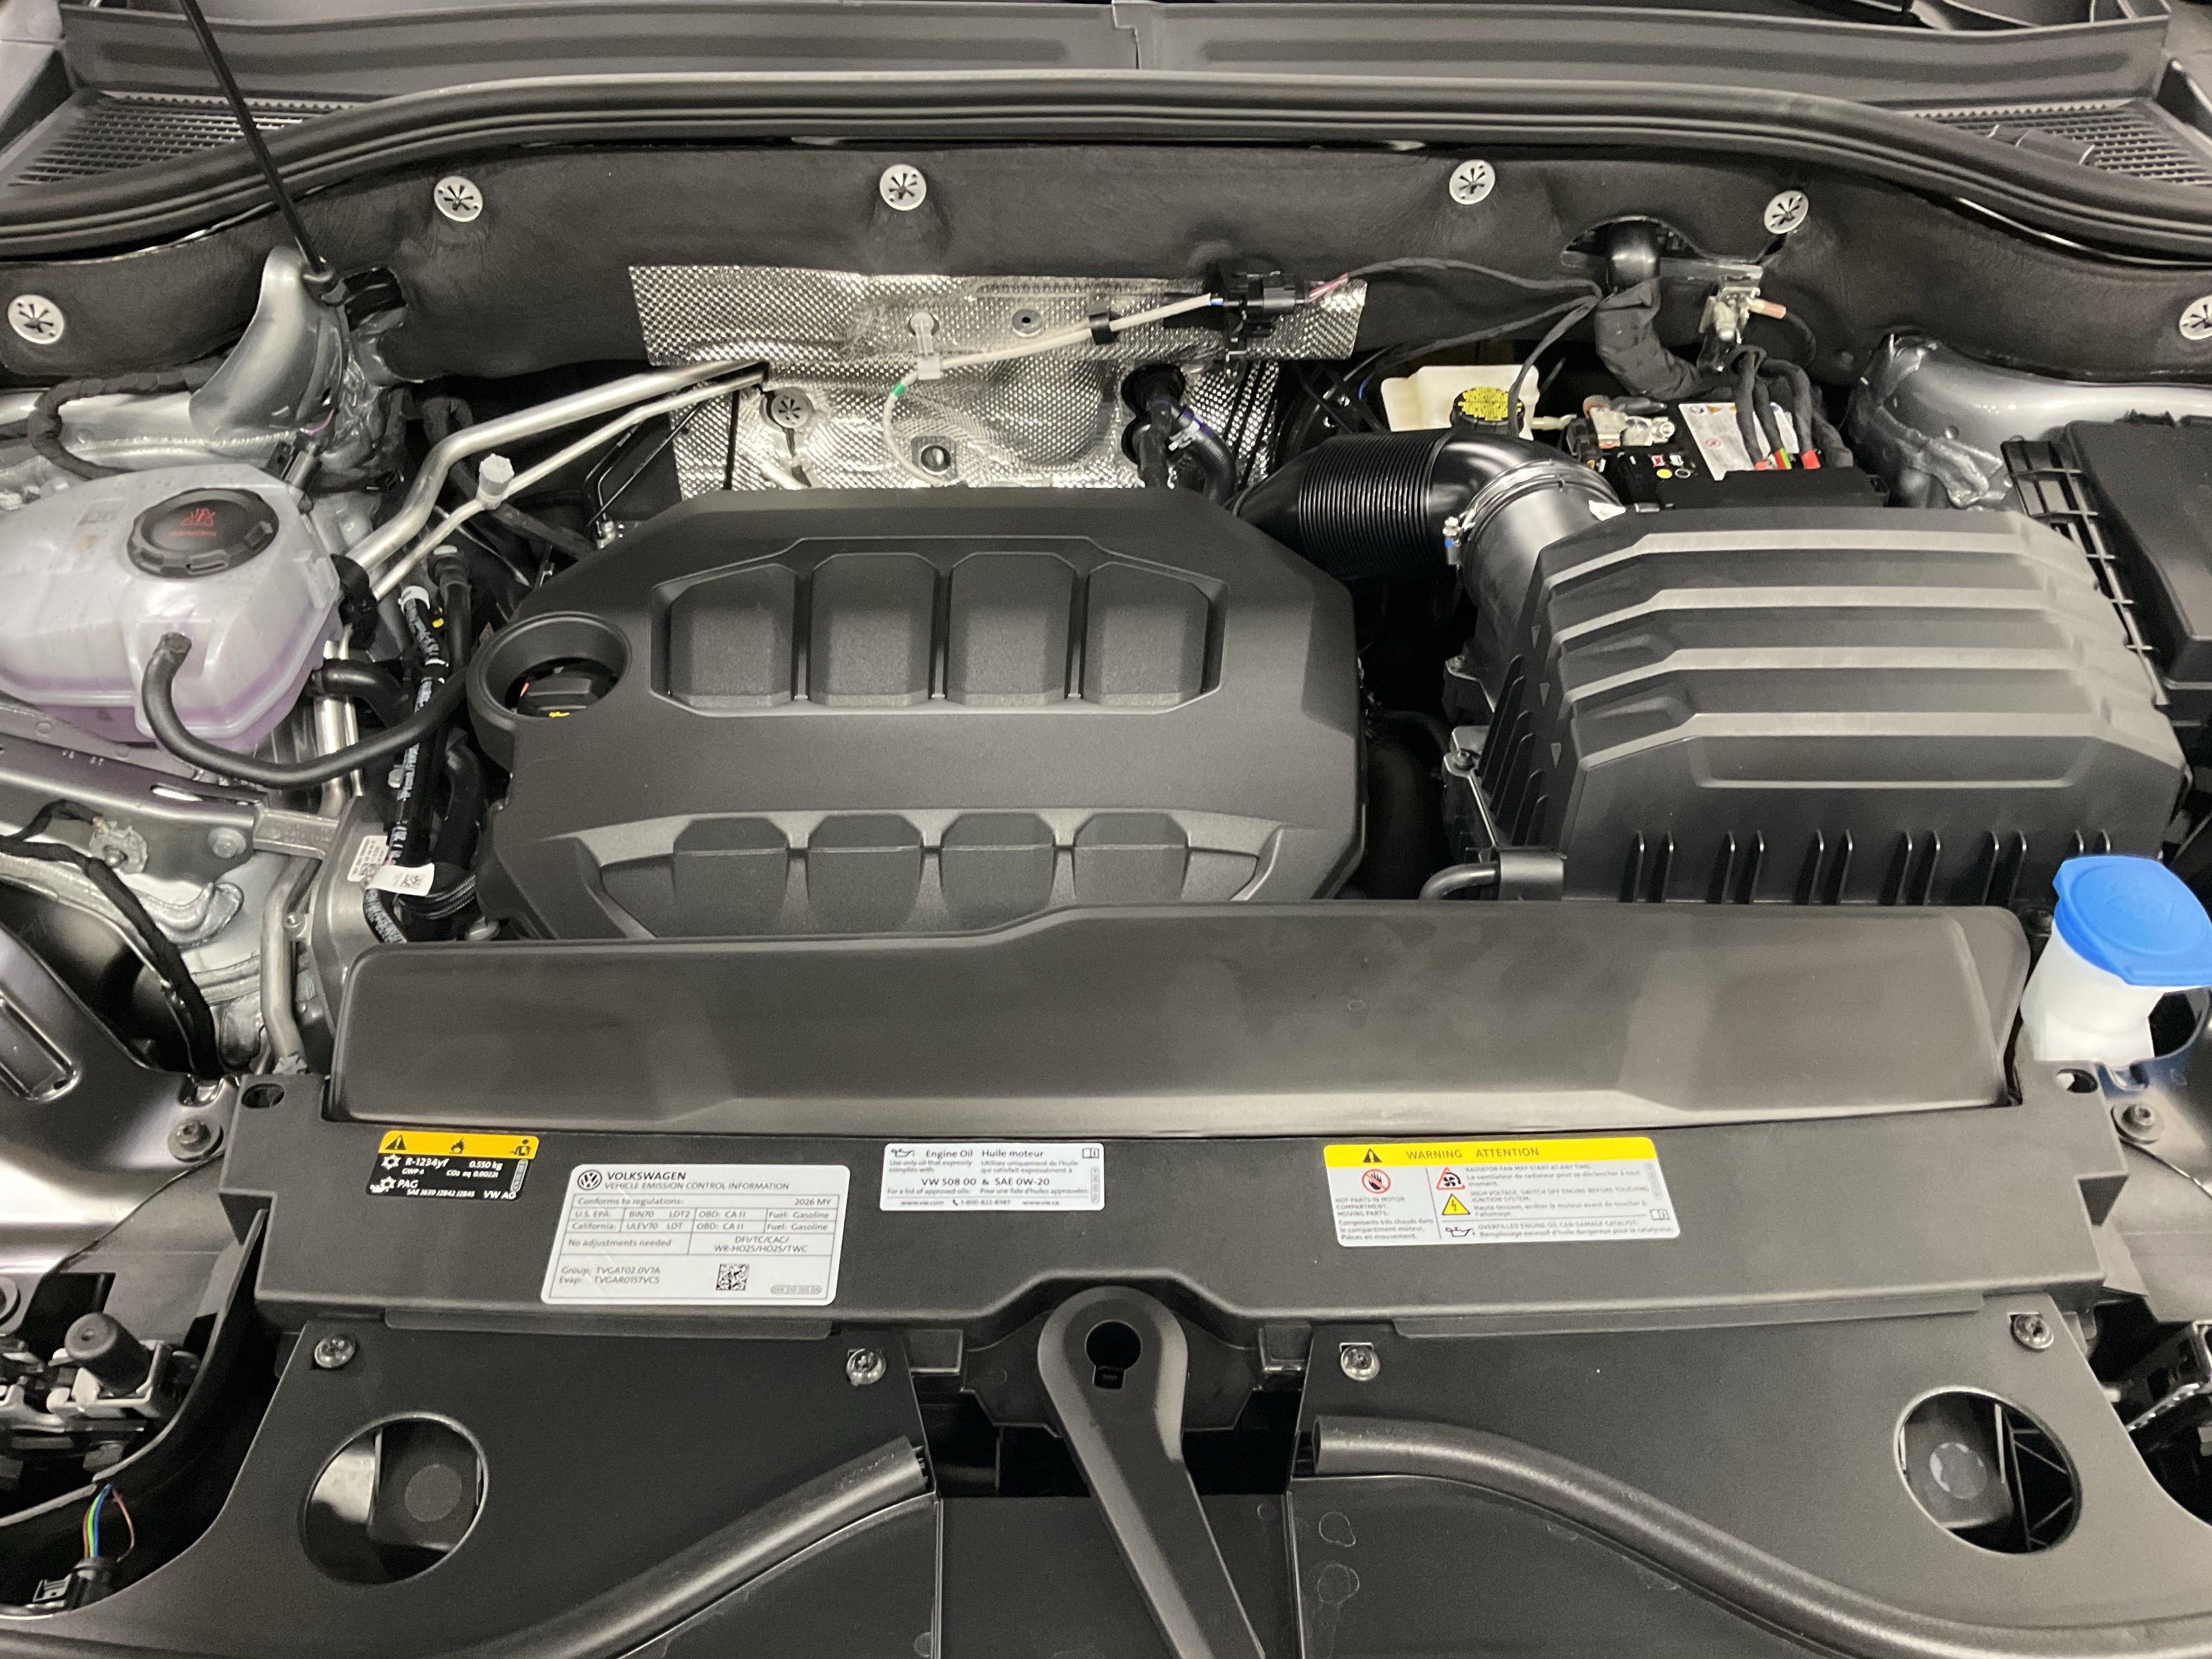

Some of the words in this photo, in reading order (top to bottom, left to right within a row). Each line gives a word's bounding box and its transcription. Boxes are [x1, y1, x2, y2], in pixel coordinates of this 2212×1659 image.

[926, 1150, 957, 1159] Engine
[1407, 1150, 1462, 1159] WARNING
[1476, 1148, 1539, 1157] ATTENTION
[405, 1158, 449, 1170] R-1234yf
[492, 1161, 503, 1171] kg
[398, 1180, 419, 1188] PAG
[686, 1182, 726, 1190] CONTROL
[583, 1239, 637, 1248] adjustments
